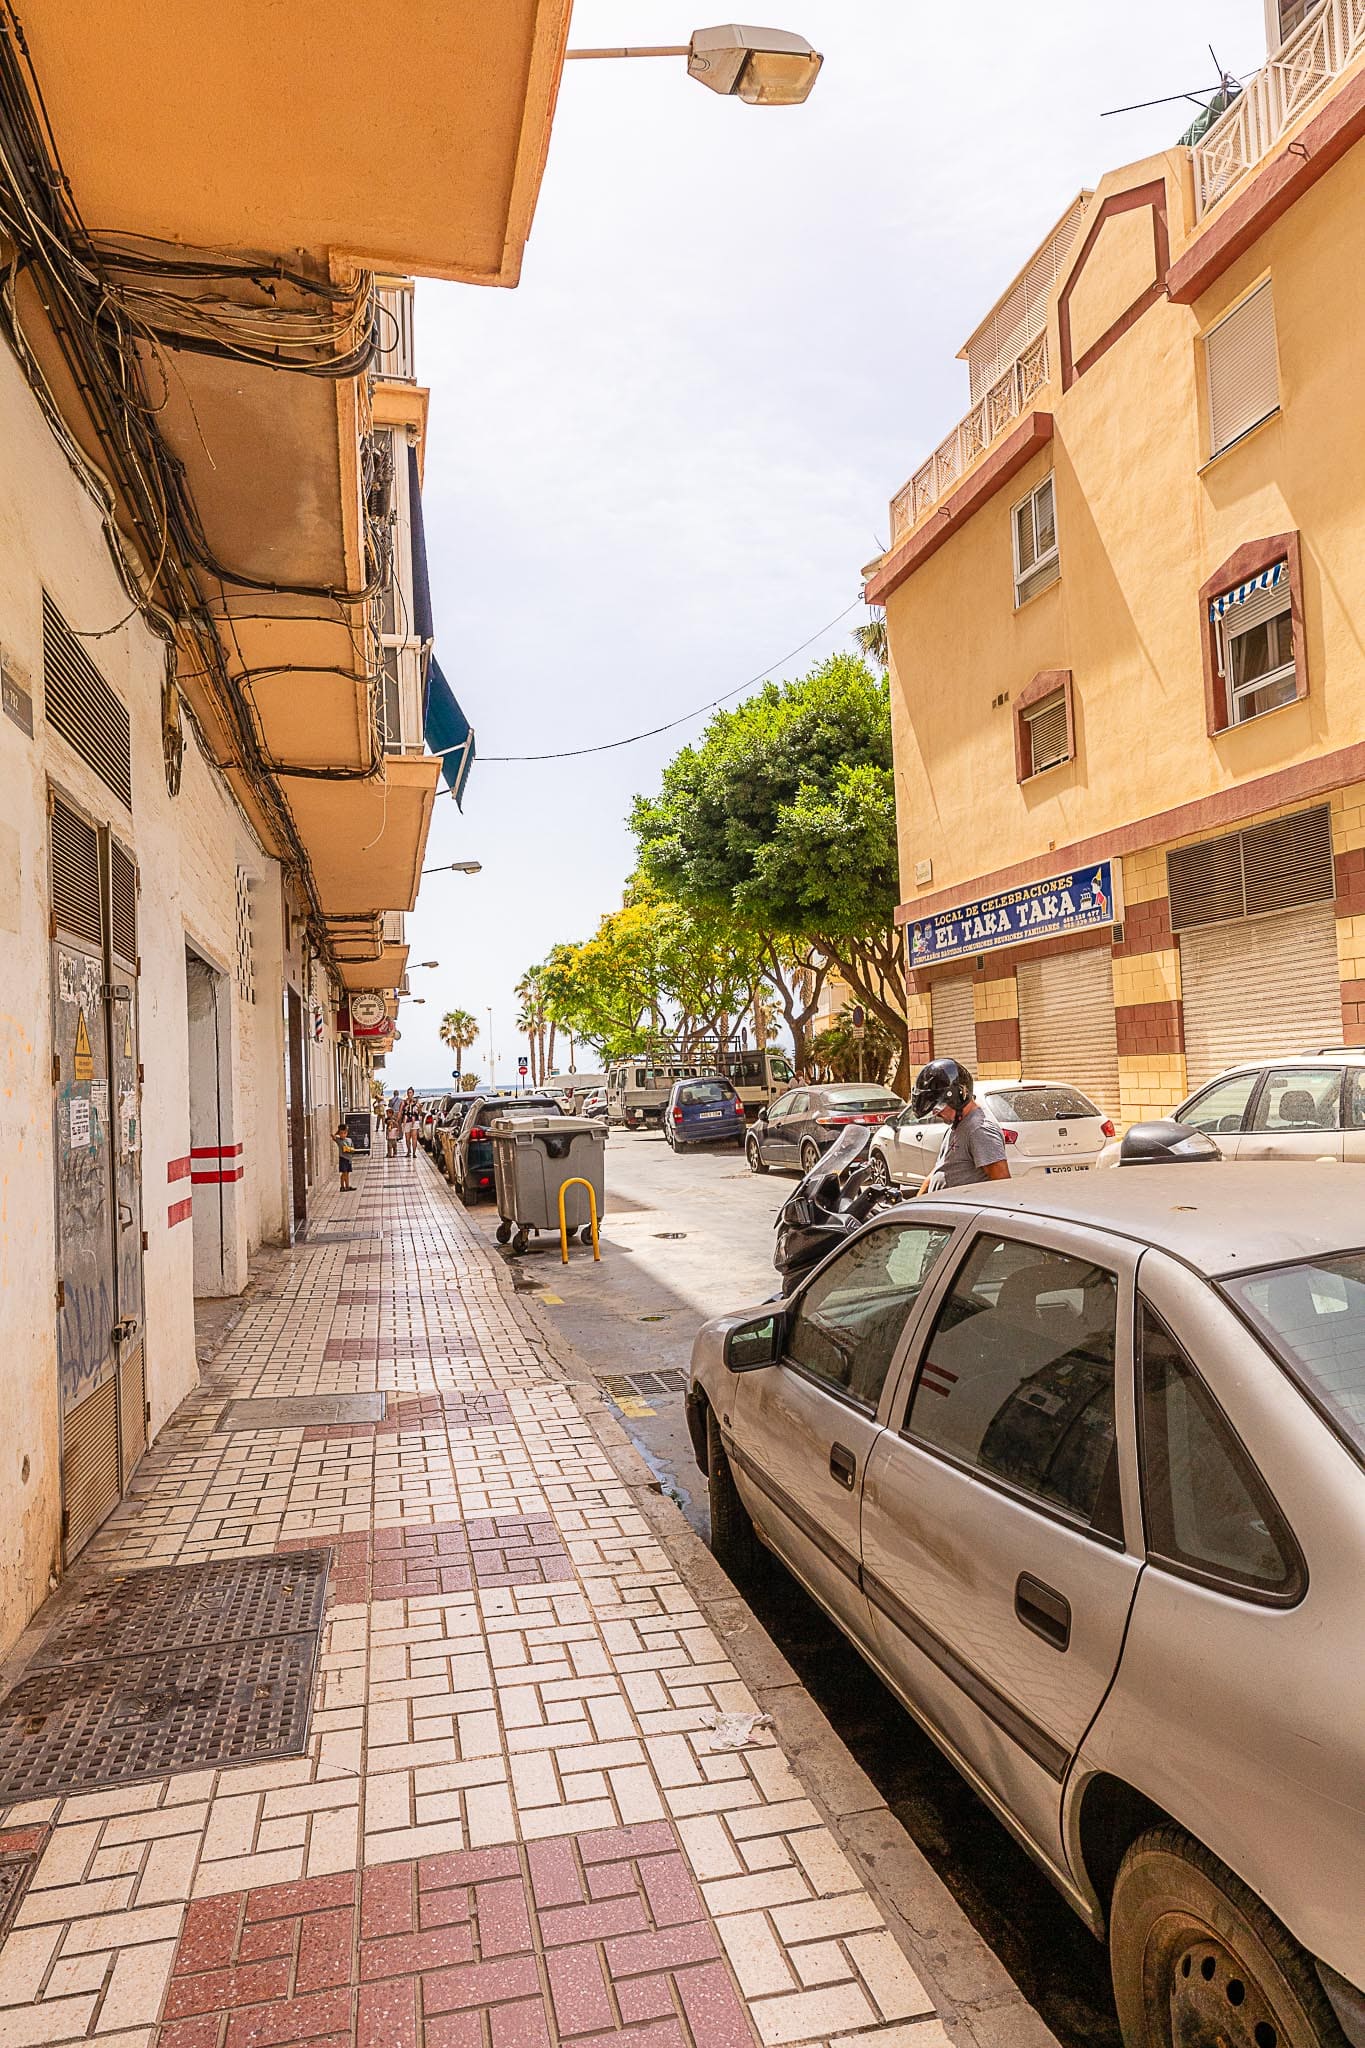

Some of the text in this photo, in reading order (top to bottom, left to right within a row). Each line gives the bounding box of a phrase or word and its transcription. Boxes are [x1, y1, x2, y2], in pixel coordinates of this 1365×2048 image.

[934, 876, 1074, 926] LOCAL DE CELEBRACIONES
[934, 890, 1076, 949] EL TAKA TAKA
